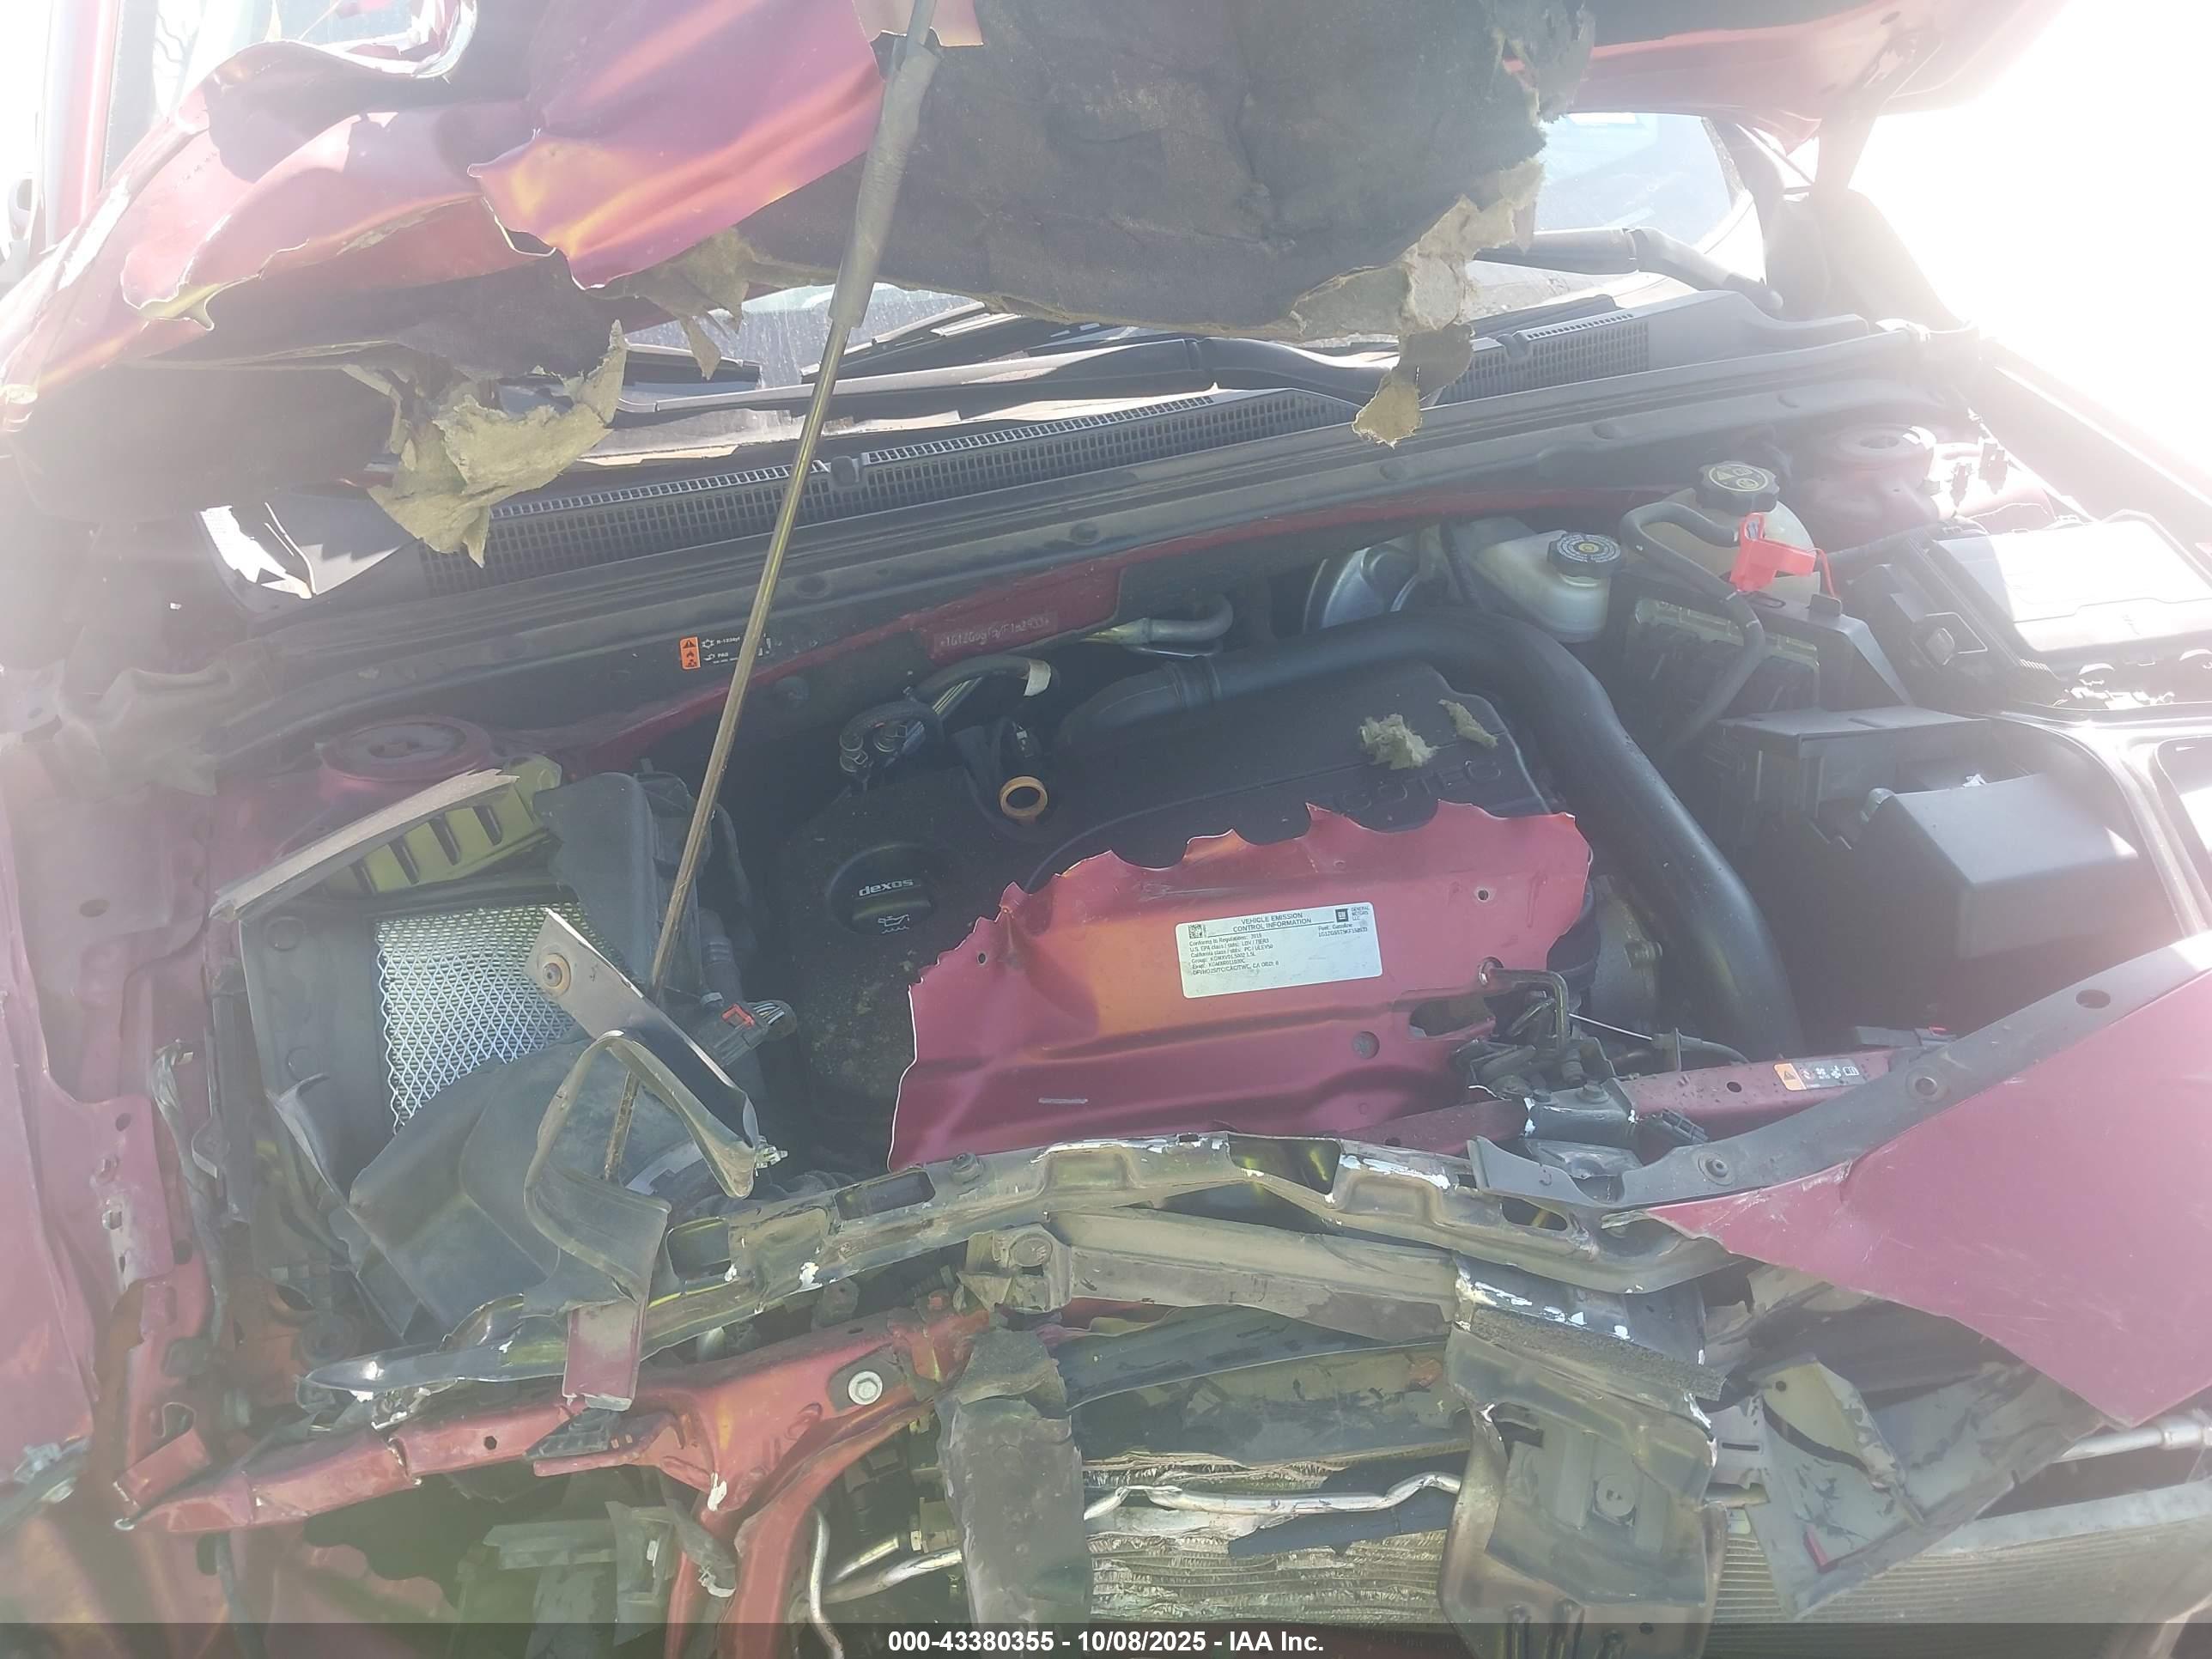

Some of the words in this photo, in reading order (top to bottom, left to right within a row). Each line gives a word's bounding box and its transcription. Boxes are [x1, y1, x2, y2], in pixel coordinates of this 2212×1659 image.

[859, 878, 914, 896] dexos
[1233, 922, 1265, 933] CONTROL
[1266, 918, 1312, 928] INFORMATION
[1241, 915, 1269, 925] VEHICLE
[1271, 912, 1303, 921] EMISSION
[1191, 950, 1213, 958] California
